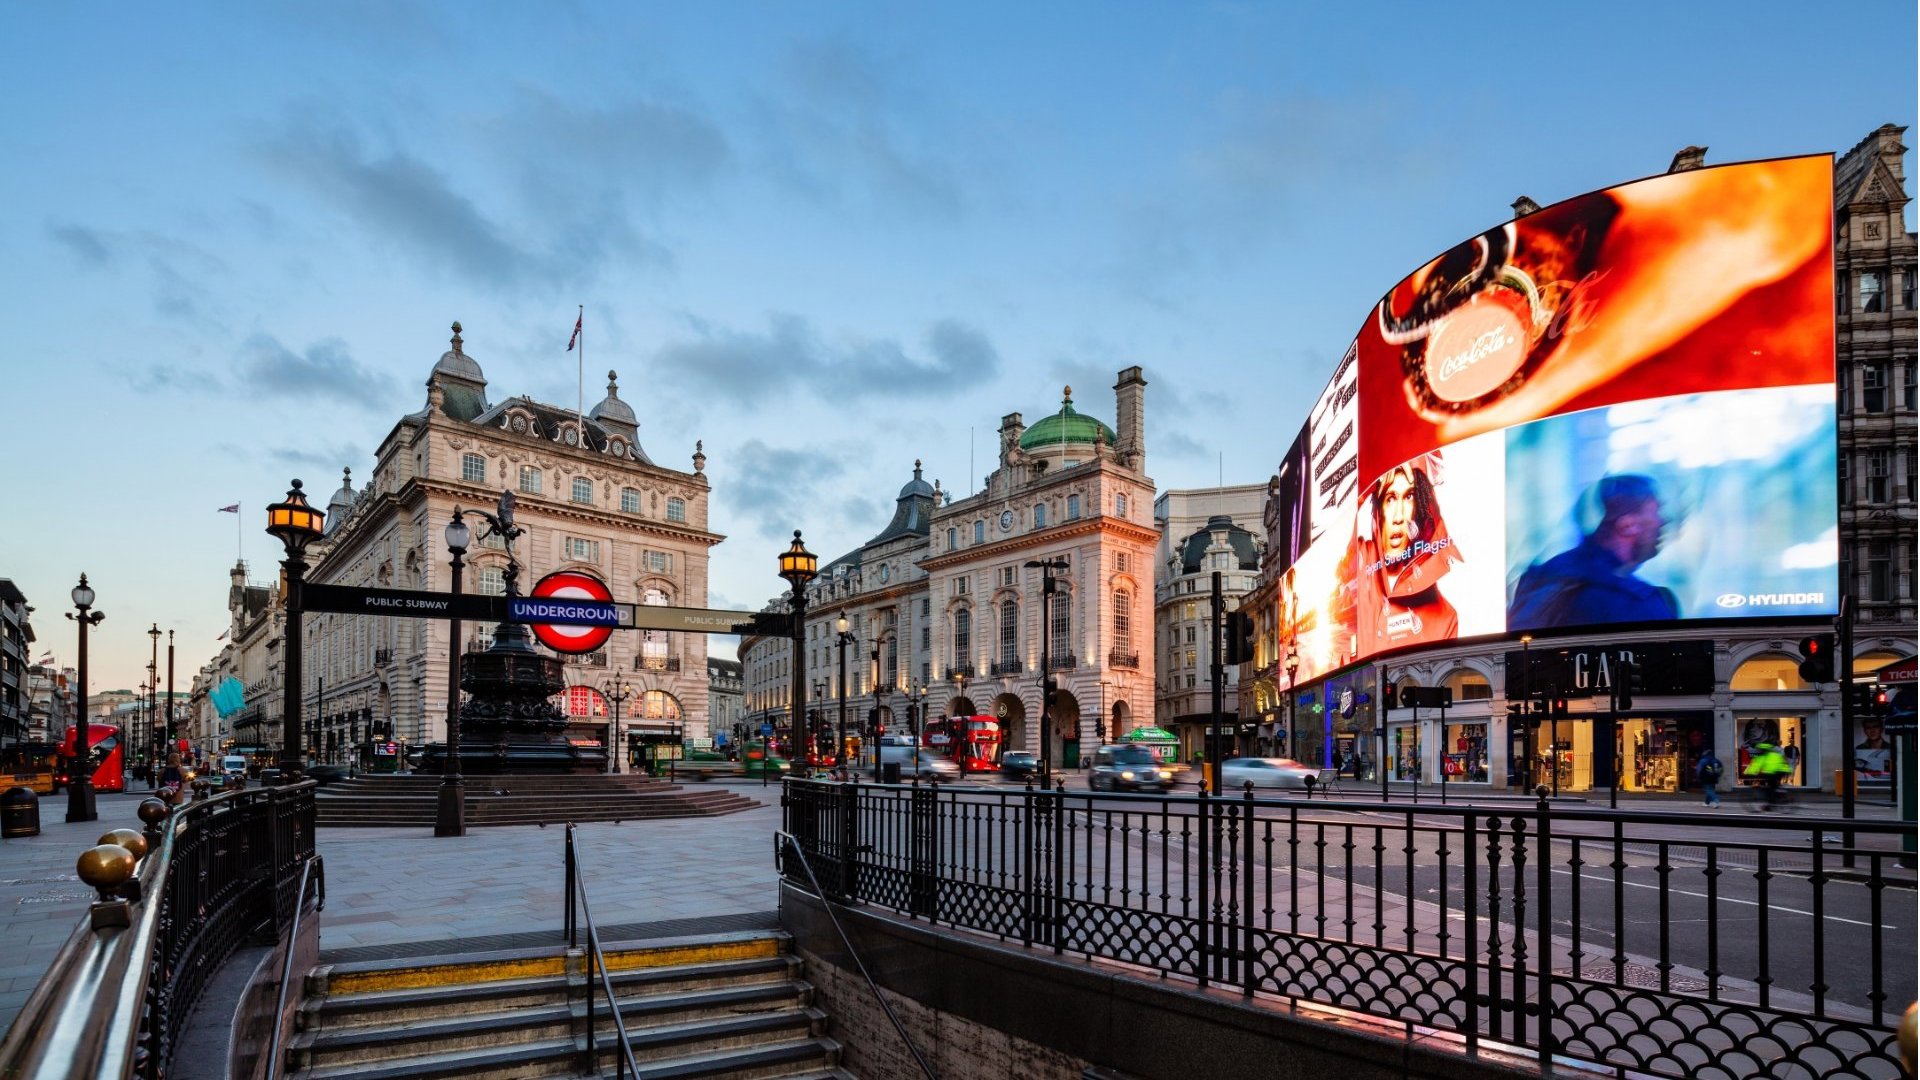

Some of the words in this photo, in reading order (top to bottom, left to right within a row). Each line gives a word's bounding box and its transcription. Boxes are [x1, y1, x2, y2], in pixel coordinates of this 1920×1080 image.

[1385, 546, 1411, 566] Street
[365, 596, 403, 607] PUBLIC
[405, 599, 449, 610] SUBWAY
[1749, 592, 1824, 606] HYUNDAI
[514, 603, 629, 621] UNDERGROUND
[684, 616, 714, 625] PUBLIC
[715, 618, 749, 627] SUBWAY
